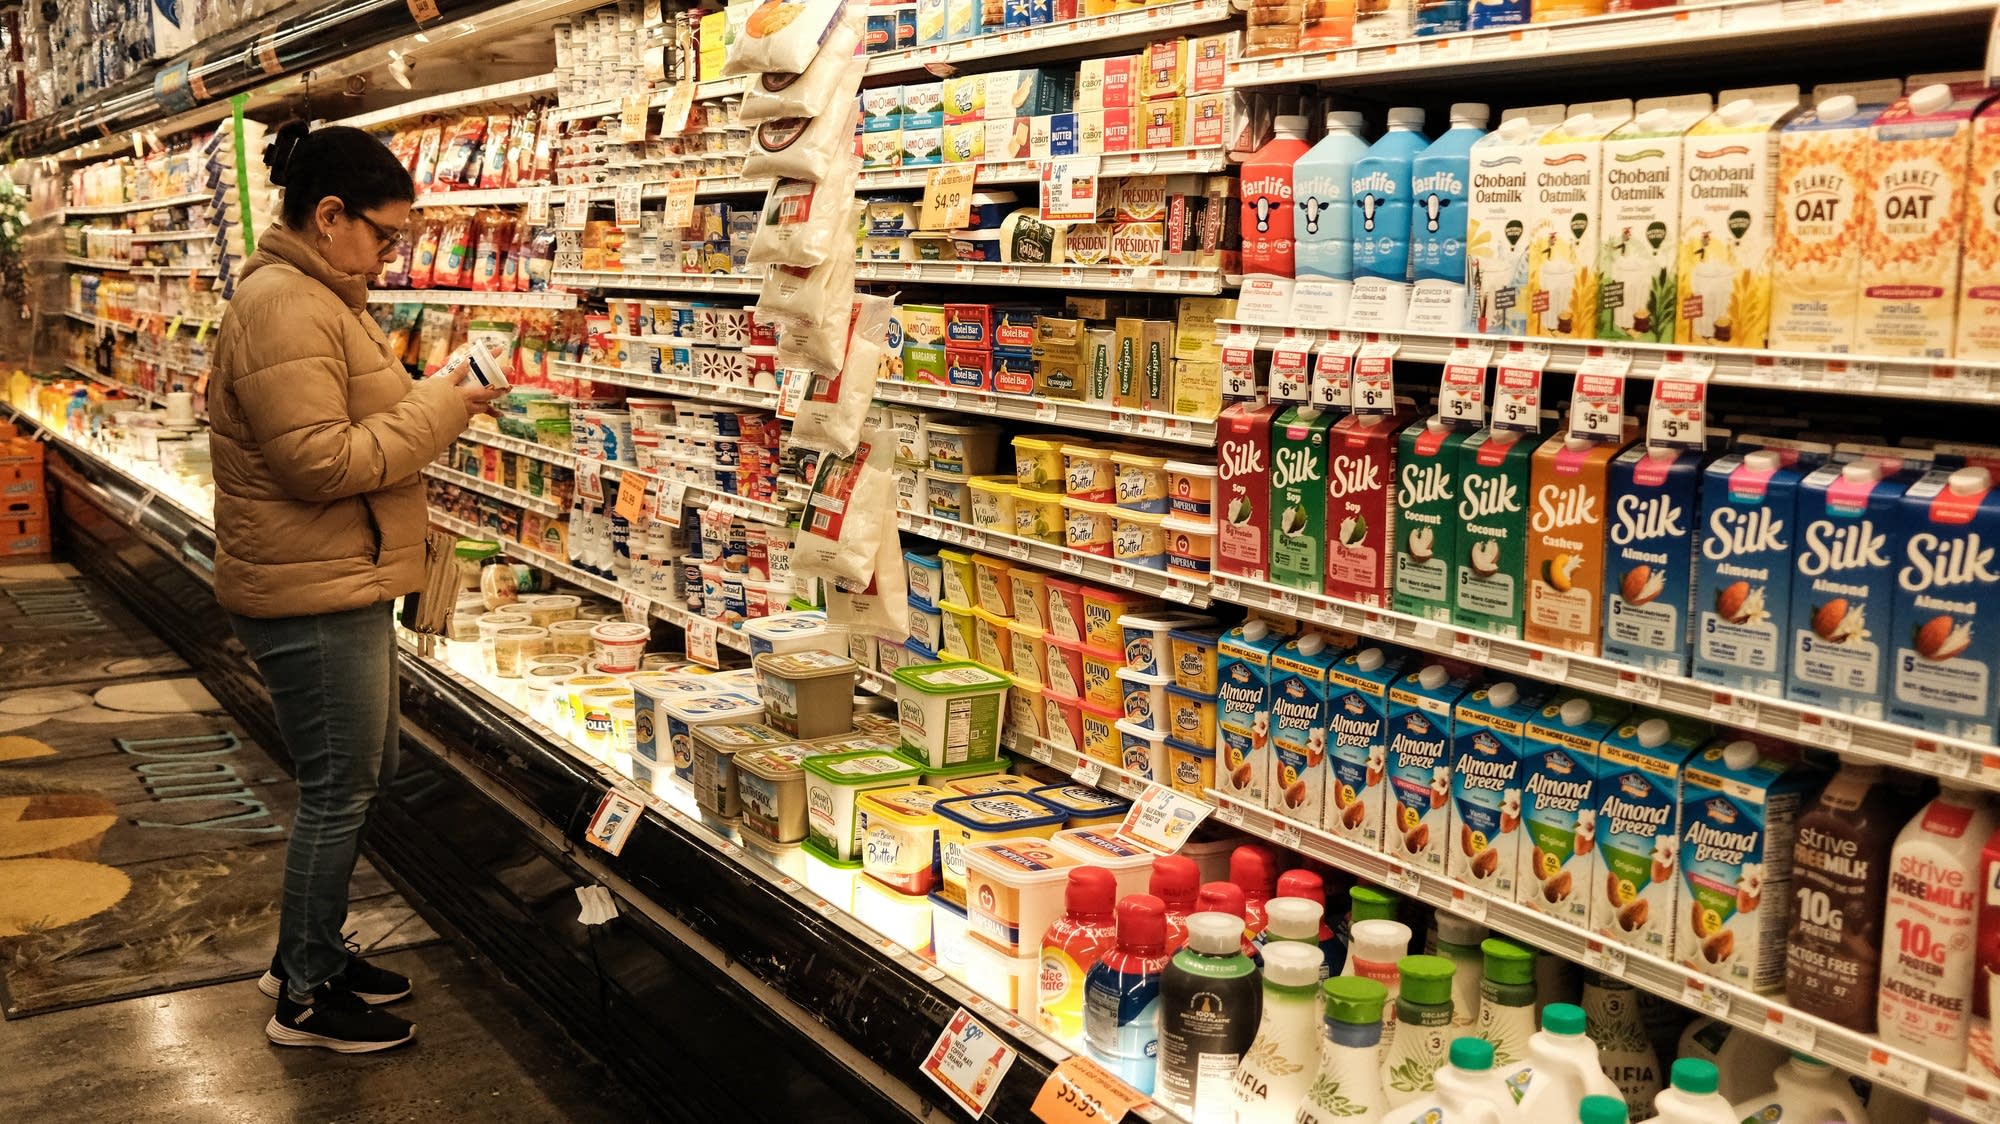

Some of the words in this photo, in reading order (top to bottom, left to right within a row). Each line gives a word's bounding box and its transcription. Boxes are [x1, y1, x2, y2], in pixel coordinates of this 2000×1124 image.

[1051, 131, 1072, 142] BUTTER
[1474, 172, 1527, 188] Chobani
[1537, 170, 1591, 187] Chobani
[1608, 166, 1670, 185] Chobani
[1689, 164, 1754, 182] Chobani
[1884, 168, 1940, 187] PLANET
[1241, 176, 1292, 198] fairlife
[1611, 184, 1665, 201] Oatmilk
[1690, 182, 1749, 199] Oatmilk
[1794, 175, 1844, 193] PLANET
[934, 192, 960, 211] $4.99
[1122, 187, 1165, 205] PRÉSIDENT
[1476, 189, 1522, 204] Oatmilk
[1539, 188, 1588, 203] Oatmilk
[1795, 199, 1841, 222] OAT
[1885, 195, 1936, 219] OAT
[1067, 236, 1107, 252] PRÉSIDENT
[1114, 237, 1161, 254] PRÉSIDENT
[907, 324, 919, 334] LAND
[920, 322, 927, 336] O
[926, 324, 941, 335] LAKES
[952, 325, 967, 334] Hotel
[968, 326, 978, 335] Bar
[1001, 329, 1017, 338] Hotel
[1018, 330, 1029, 339] Bar
[911, 351, 937, 363] MARGARINE
[953, 370, 968, 379] Hotel
[968, 371, 979, 380] Bar
[1000, 375, 1015, 384] Hotel
[1016, 376, 1027, 386] Bar
[1219, 440, 1264, 480] Silk
[1273, 446, 1321, 489] Silk
[1069, 470, 1096, 491] Butter!
[1330, 454, 1382, 498] Silk
[1398, 462, 1454, 508] Silk
[1119, 478, 1147, 500] Butter!
[1232, 483, 1246, 494] Soy
[1287, 492, 1301, 503] Soy
[1459, 473, 1520, 520] Silk
[1173, 499, 1198, 513] IMPERIAL
[1345, 501, 1361, 514] Soy
[1532, 484, 1599, 532] Silk
[1405, 510, 1442, 525] Coconut
[1610, 494, 1685, 546] Silk
[1069, 523, 1096, 543] Butter!
[1466, 523, 1508, 538] Coconut
[1703, 506, 1788, 560] Silk
[1117, 534, 1145, 555] Butter!
[1543, 535, 1584, 551] Cashew
[1798, 520, 1890, 576] Silk
[1170, 555, 1197, 569] IMPERIAL
[1400, 557, 1406, 570] 5
[1621, 548, 1668, 565] Almond
[1898, 533, 2000, 592] Silk
[1717, 562, 1768, 581] Almond
[1812, 578, 1869, 598] Almond
[1086, 604, 1110, 622] OLIVIO
[1914, 594, 1977, 615] Almond
[1184, 653, 1198, 663] Blue
[1243, 649, 1262, 660] CALCIUM
[1085, 662, 1110, 681] OLIVIO
[1180, 661, 1203, 672] Bonnet
[1300, 664, 1319, 675] CALCIUM
[1219, 682, 1264, 703] Almond
[1180, 707, 1194, 717] Blue
[1225, 700, 1255, 713] Breeze
[1272, 697, 1319, 719] Almond
[1085, 719, 1109, 738] OLIVIO
[1178, 716, 1199, 727] Bonnet
[1279, 715, 1310, 729] Breeze
[1329, 714, 1380, 737] Almond
[1336, 732, 1370, 748] Breeze
[1390, 733, 1445, 757] Almond
[1181, 761, 1194, 772] Blue
[1398, 752, 1434, 769] Breeze
[1455, 753, 1517, 779] Almond
[1178, 769, 1200, 780] Bonnet
[1464, 774, 1505, 791] Breeze
[1525, 773, 1592, 800] Almond
[1535, 794, 1580, 812] Breeze
[1600, 795, 1671, 825] Almond
[1470, 808, 1491, 821] Vanilla
[1609, 817, 1657, 837] Breeze
[1684, 820, 1758, 852] Almond
[949, 842, 962, 856] Blu
[1539, 833, 1567, 849] Original
[1800, 828, 1858, 857] strive
[867, 843, 898, 866] Butter!
[945, 852, 965, 868] Bonn
[1694, 843, 1744, 865] Breeze
[1614, 859, 1642, 875] Original
[1901, 855, 1963, 888] strive
[1892, 872, 1974, 911] FREEMILK
[1797, 887, 1843, 931] 10G
[1799, 922, 1841, 943] PROTEIN
[1896, 918, 1946, 964] 10G
[1828, 957, 1859, 976] FREE
[1898, 954, 1944, 978] PROTEIN
[1806, 976, 1819, 988] 25
[1833, 985, 1846, 997] 97
[1929, 993, 1963, 1012] FREE
[294, 1007, 314, 1025] PUMA
[1432, 1038, 1440, 1048] 3
